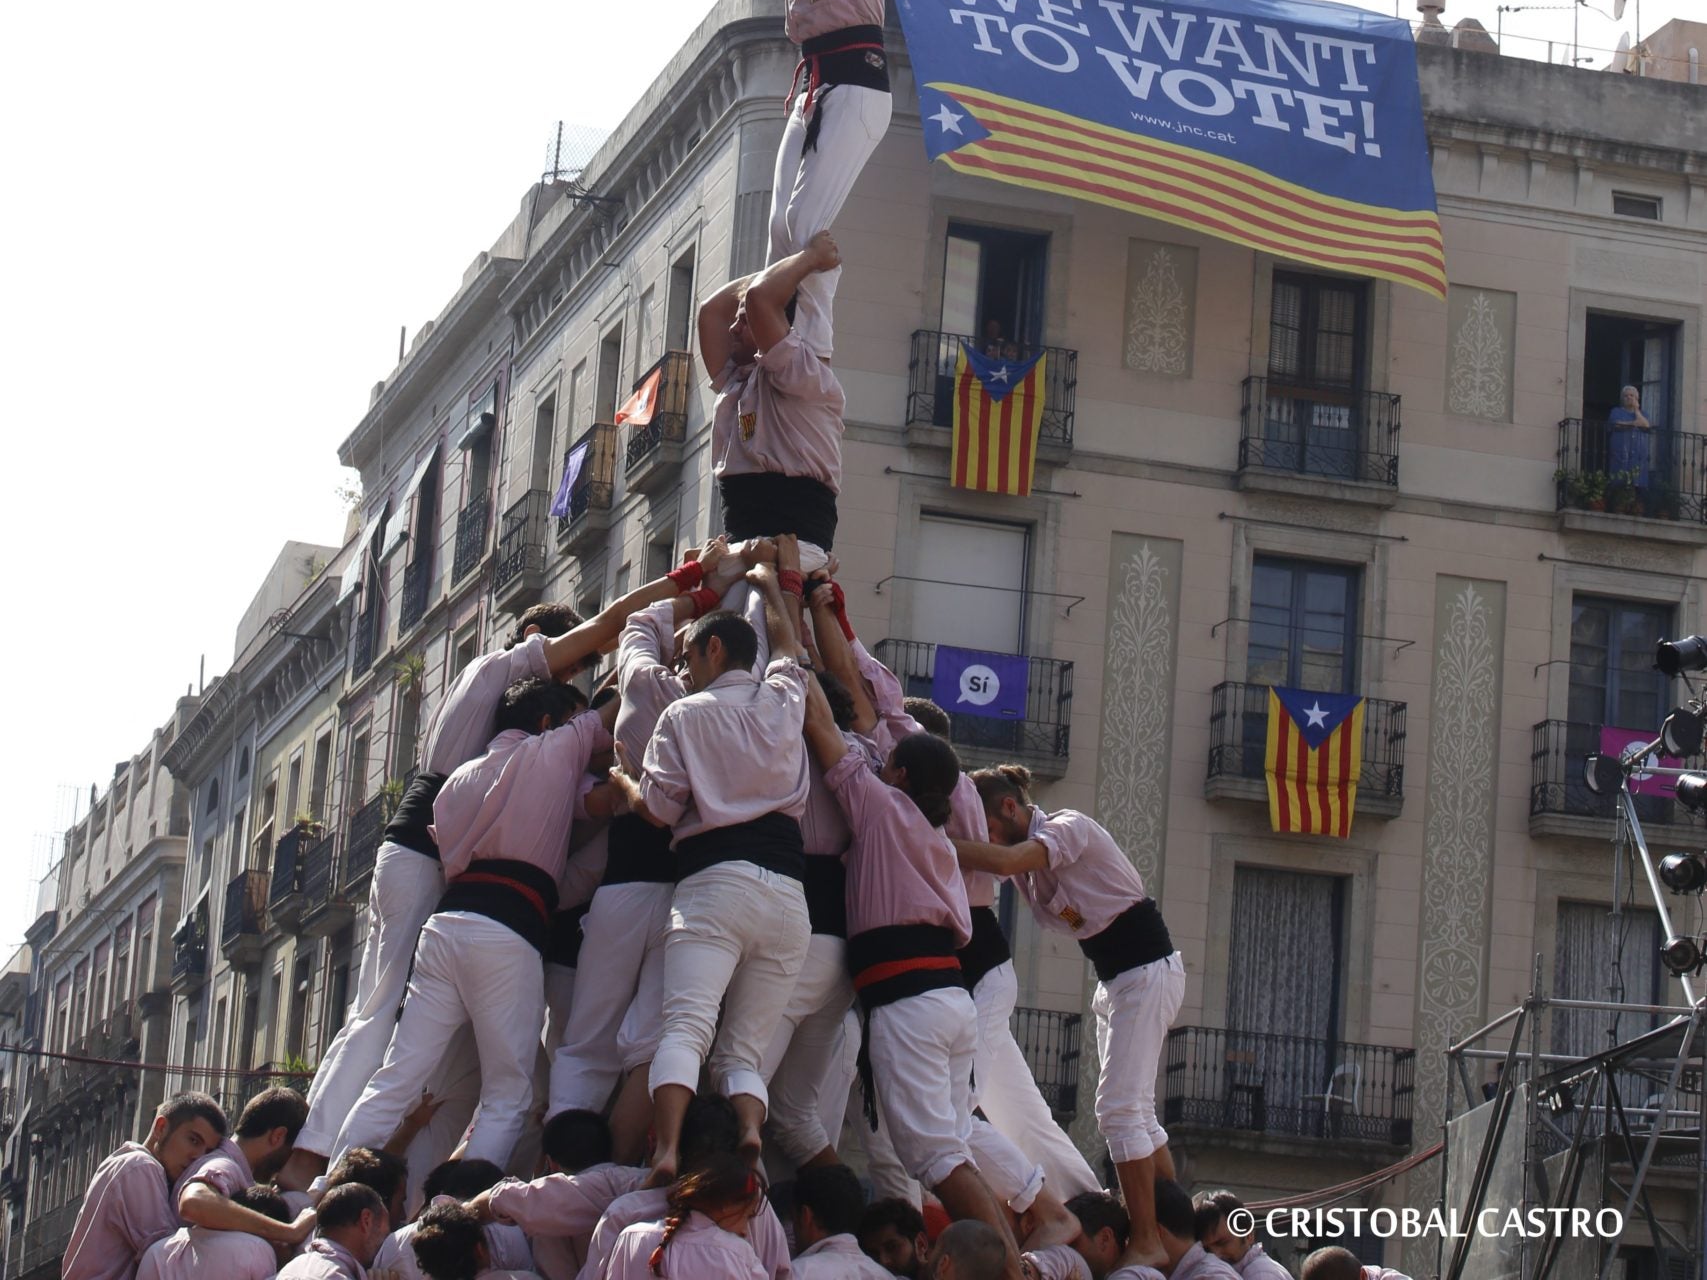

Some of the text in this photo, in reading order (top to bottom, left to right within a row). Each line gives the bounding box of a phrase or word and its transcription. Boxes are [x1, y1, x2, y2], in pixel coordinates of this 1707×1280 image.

[1099, 0, 1377, 93] WANT
[950, 9, 1382, 158] TO VOTE!
[1130, 111, 1237, 144] www.jnc.cat
[968, 676, 989, 693] Sí
